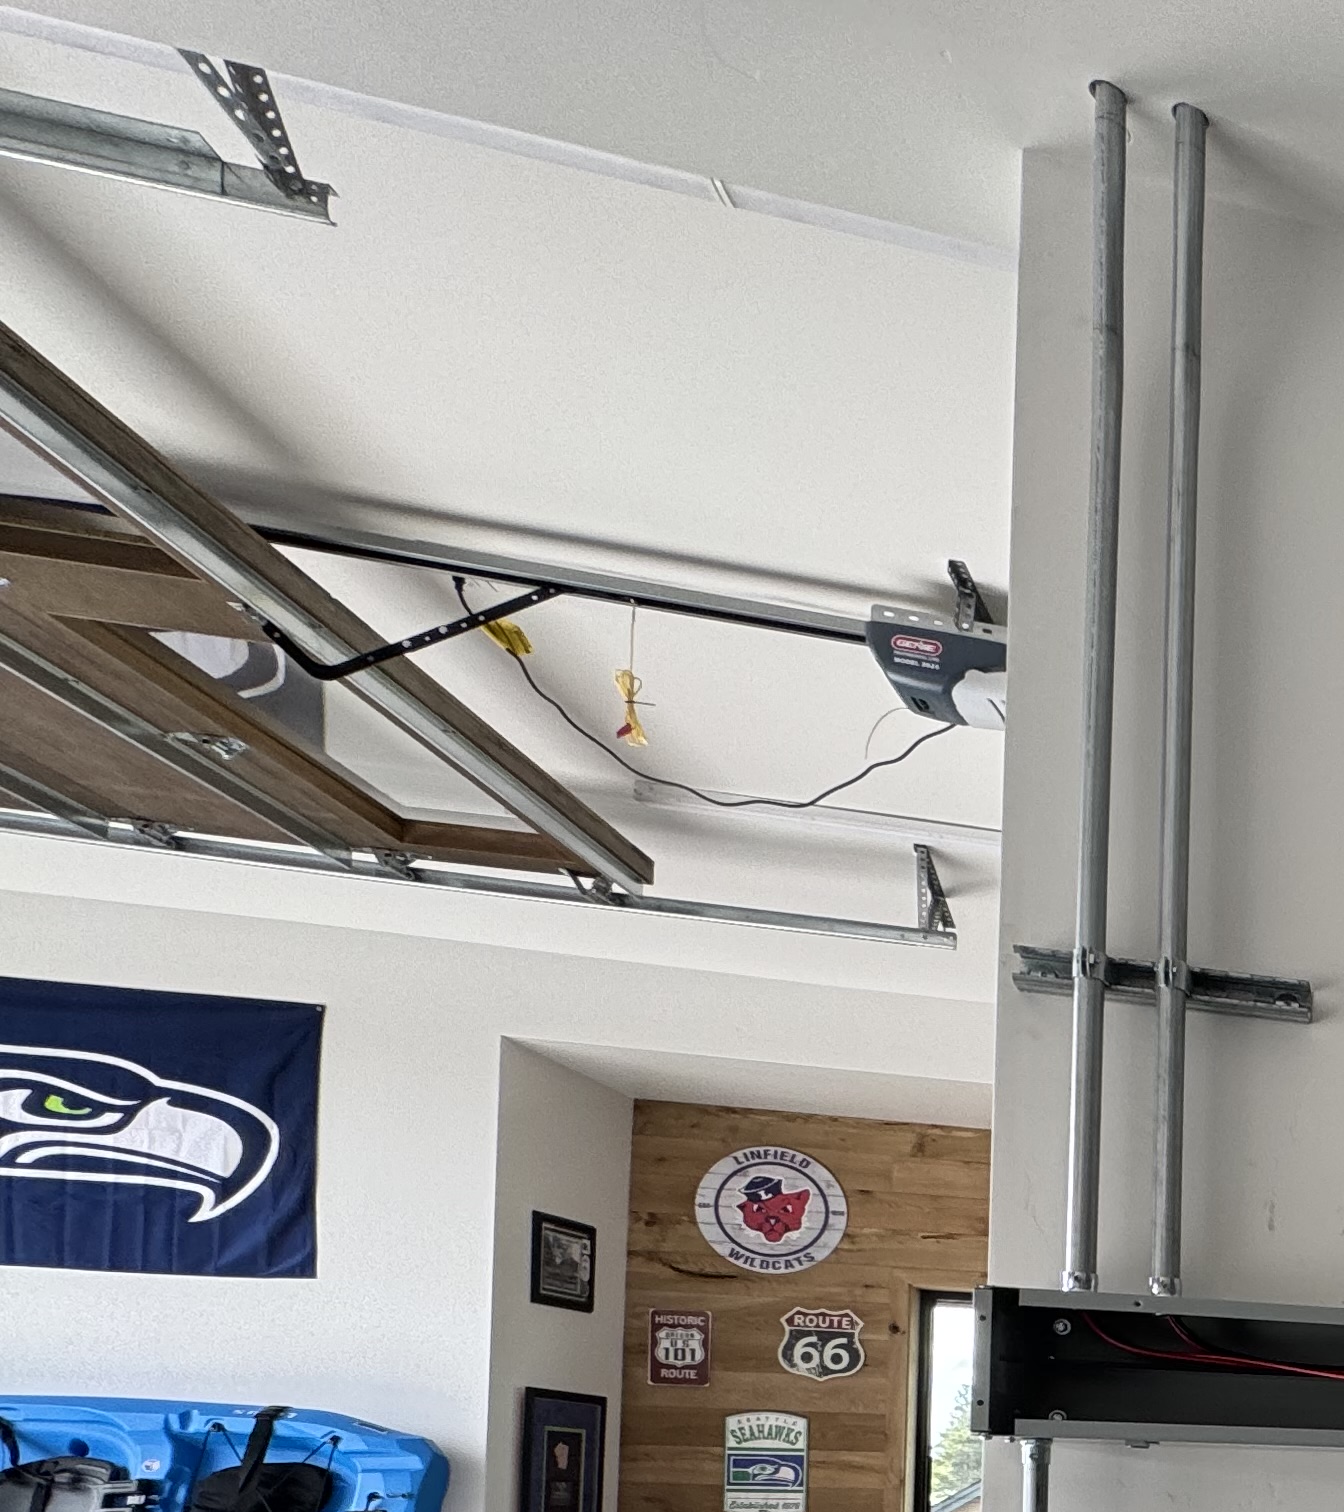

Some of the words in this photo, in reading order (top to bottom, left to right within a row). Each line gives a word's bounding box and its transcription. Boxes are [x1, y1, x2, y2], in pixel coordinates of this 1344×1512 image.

[893, 656, 920, 667] MODEL
[733, 1149, 811, 1169] LINFIELD
[728, 1247, 815, 1271] WILDCATS
[655, 1315, 706, 1326] HISTORIC
[793, 1314, 852, 1329] ROUTE
[662, 1347, 697, 1361] 101
[793, 1336, 850, 1371] 66
[661, 1369, 698, 1379] ROUTE
[737, 1416, 798, 1426] SEATTLE
[730, 1424, 802, 1446] SEAHAWKS
